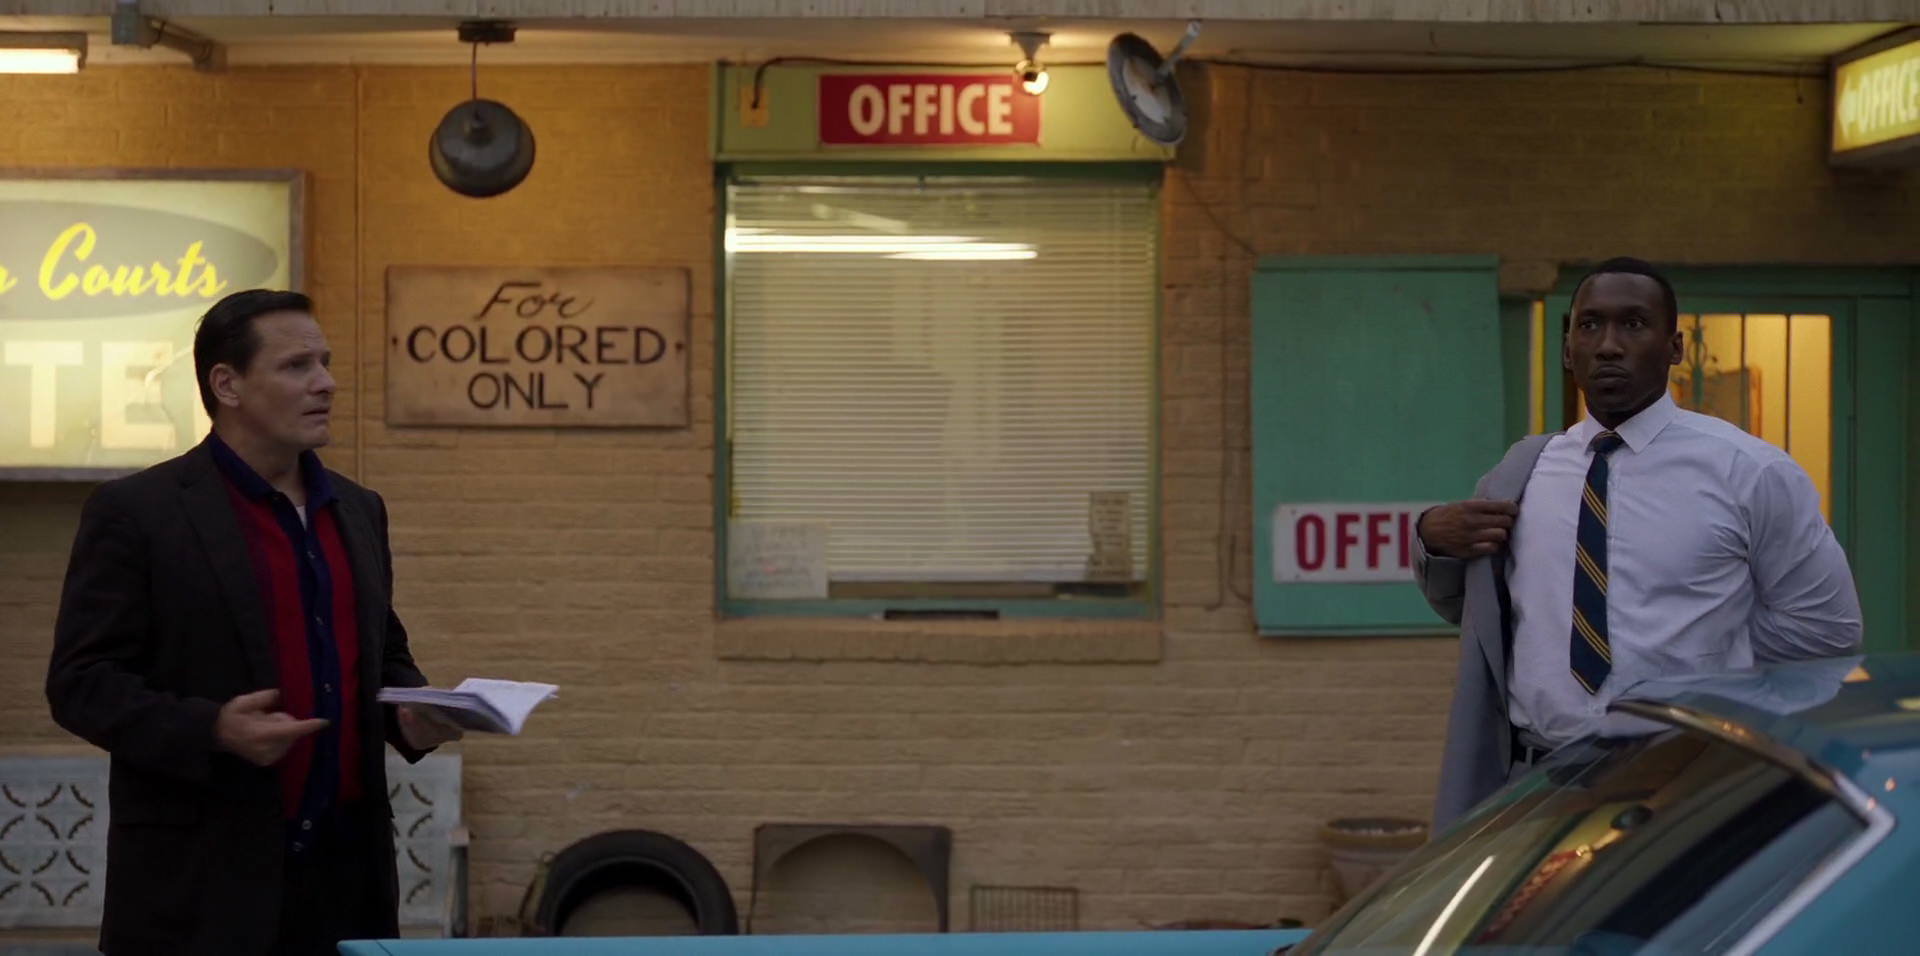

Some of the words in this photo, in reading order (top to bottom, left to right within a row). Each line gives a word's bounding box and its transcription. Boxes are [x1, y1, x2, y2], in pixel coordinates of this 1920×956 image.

[848, 84, 1015, 136] OFFICE
[38, 222, 228, 301] Courts
[473, 281, 595, 321] For
[406, 324, 667, 365] COLORED
[467, 372, 606, 410] ONLY
[1296, 512, 1411, 572] OFFI
